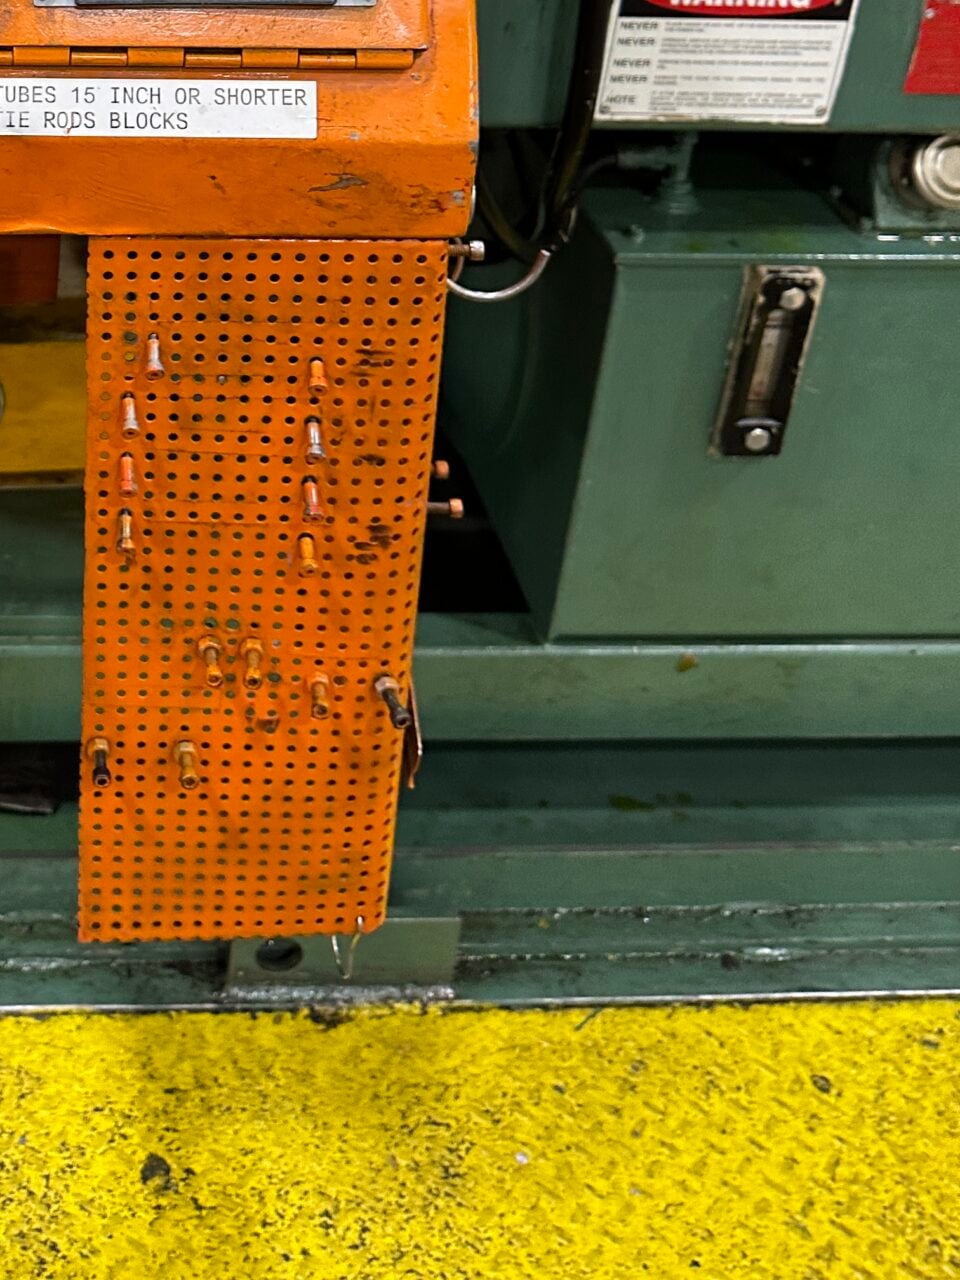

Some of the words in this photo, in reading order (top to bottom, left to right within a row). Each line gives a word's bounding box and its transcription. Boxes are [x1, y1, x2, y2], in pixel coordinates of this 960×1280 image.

[621, 21, 658, 30] NEVER
[618, 37, 655, 46] NEVER
[613, 59, 651, 67] NEVER
[609, 75, 648, 83] NEVER
[71, 87, 96, 104] 15
[110, 87, 161, 105] INCH
[175, 87, 201, 105] OR
[214, 88, 308, 106] SHORTER
[43, 111, 96, 129] RODS
[110, 112, 189, 130] BLOCKS
